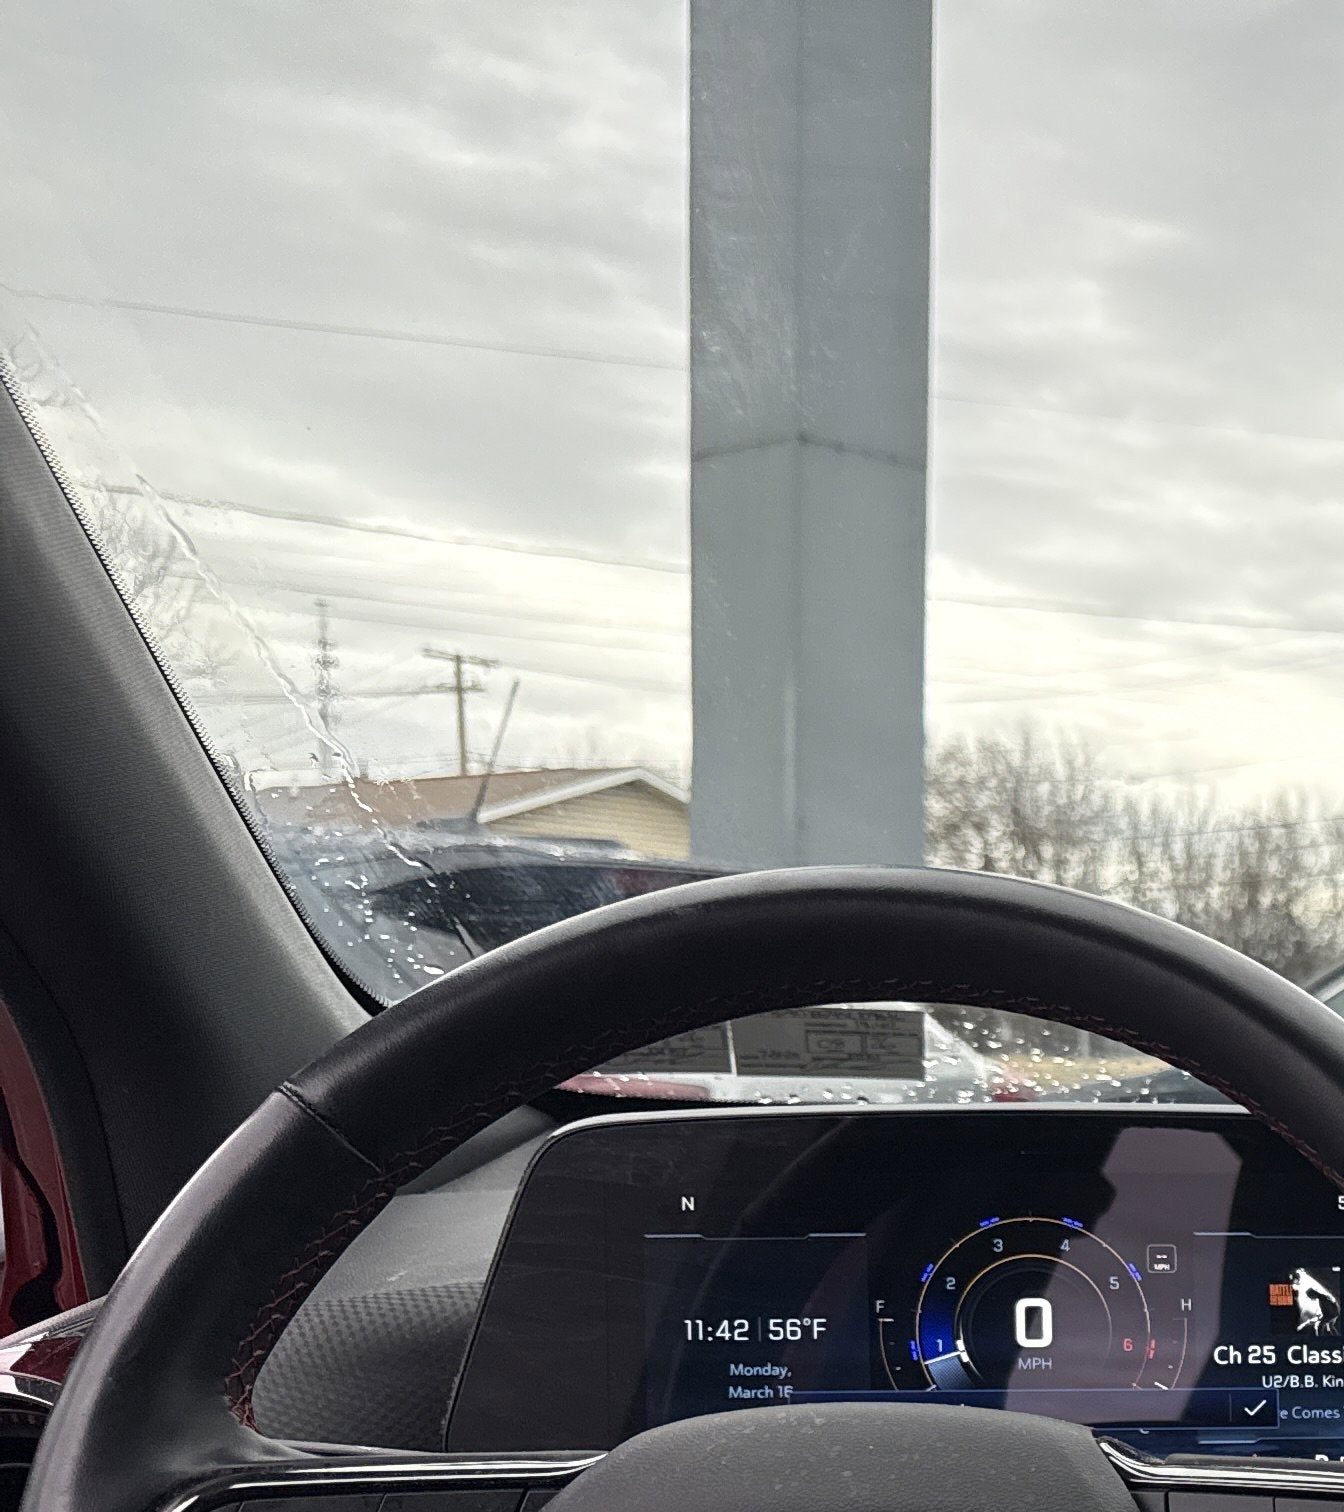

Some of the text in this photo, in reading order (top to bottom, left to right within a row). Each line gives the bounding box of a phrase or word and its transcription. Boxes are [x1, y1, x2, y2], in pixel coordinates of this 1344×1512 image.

[681, 1196, 695, 1212] N
[992, 1239, 1004, 1252] 3
[1060, 1239, 1071, 1252] 4
[946, 1277, 956, 1290] 2
[1109, 1277, 1120, 1290] 5
[875, 1300, 885, 1314] F
[1180, 1298, 1192, 1312] H
[684, 1317, 827, 1342] 11:42 56°F
[1015, 1297, 1053, 1348] 0
[936, 1339, 943, 1352] 1
[1122, 1338, 1133, 1352] 6
[1213, 1345, 1241, 1365] Ch
[1248, 1346, 1277, 1365] 25
[729, 1361, 793, 1380] Monday,
[1017, 1358, 1053, 1371] MPH
[1261, 1374, 1318, 1390] U2/B.B.
[728, 1385, 774, 1400] March
[1292, 1405, 1341, 1420] Comes
